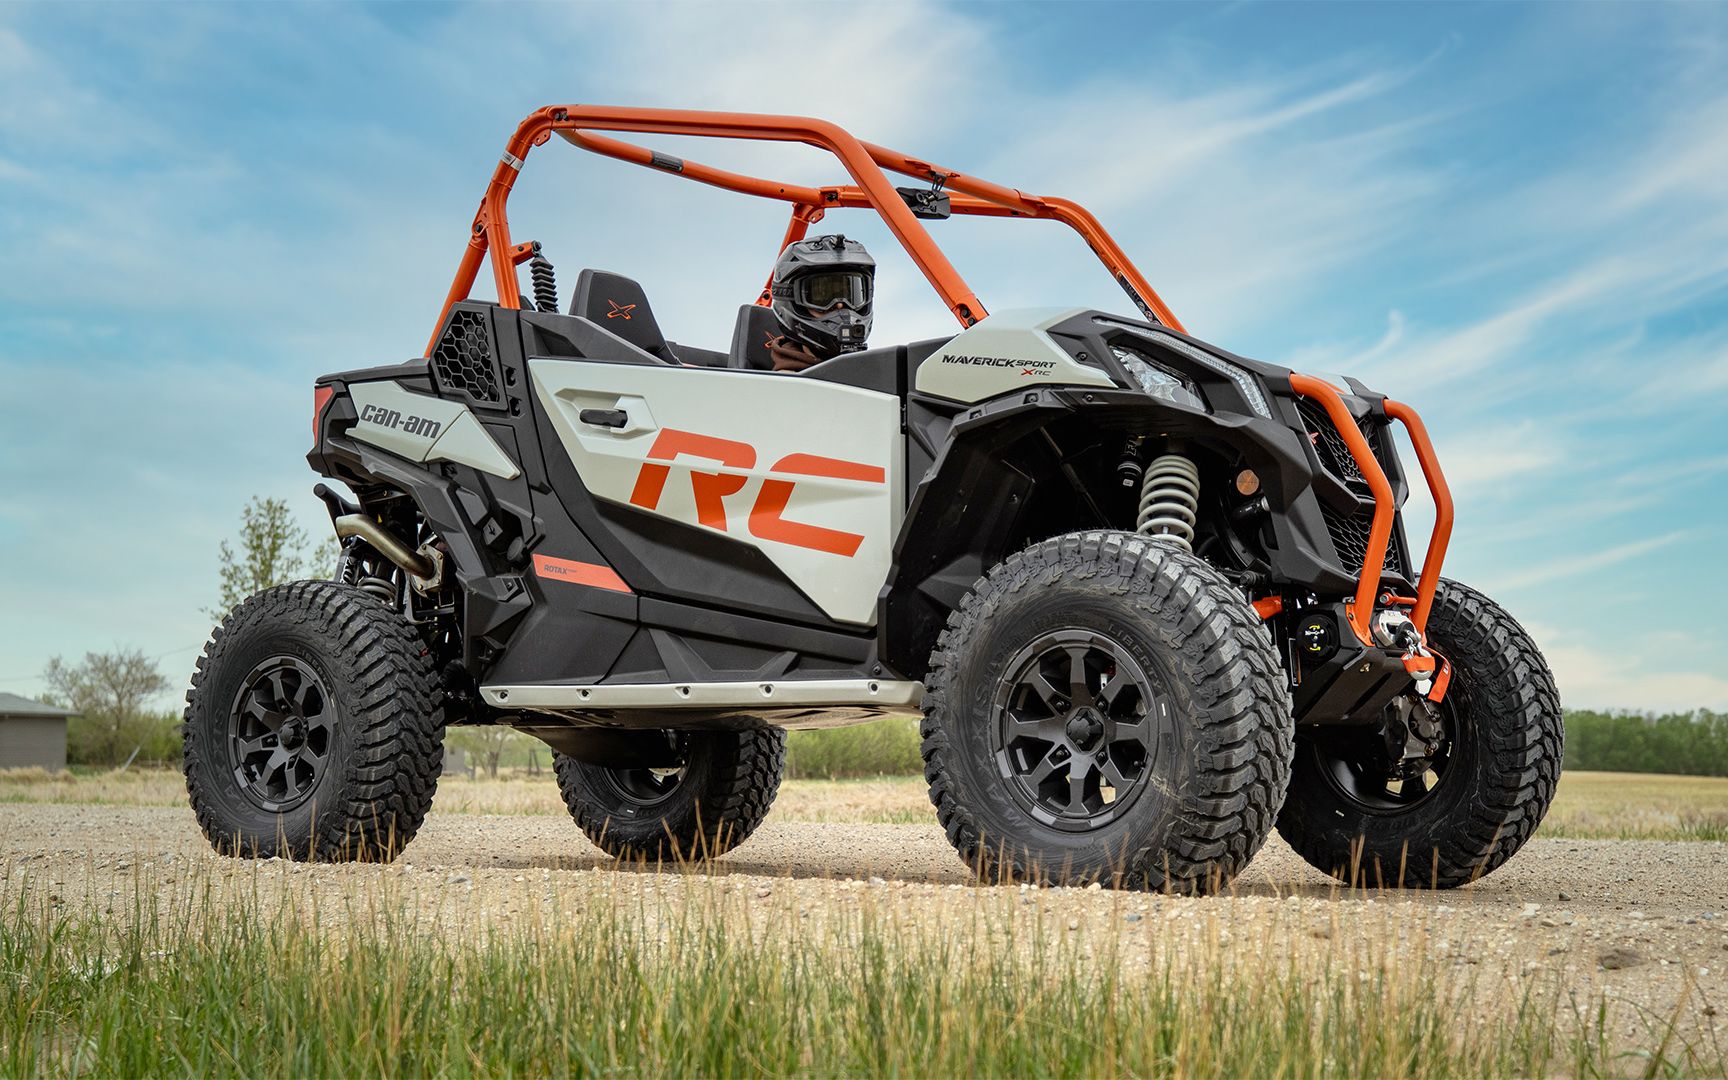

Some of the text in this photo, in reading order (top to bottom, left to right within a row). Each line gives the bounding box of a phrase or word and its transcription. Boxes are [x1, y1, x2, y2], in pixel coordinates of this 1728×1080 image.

[942, 354, 1056, 369] MAVERICK SPORT
[360, 403, 441, 439] can-am
[629, 427, 885, 558] RC
[544, 564, 567, 575] ROTAX
[1108, 623, 1162, 690] LIBERTY
